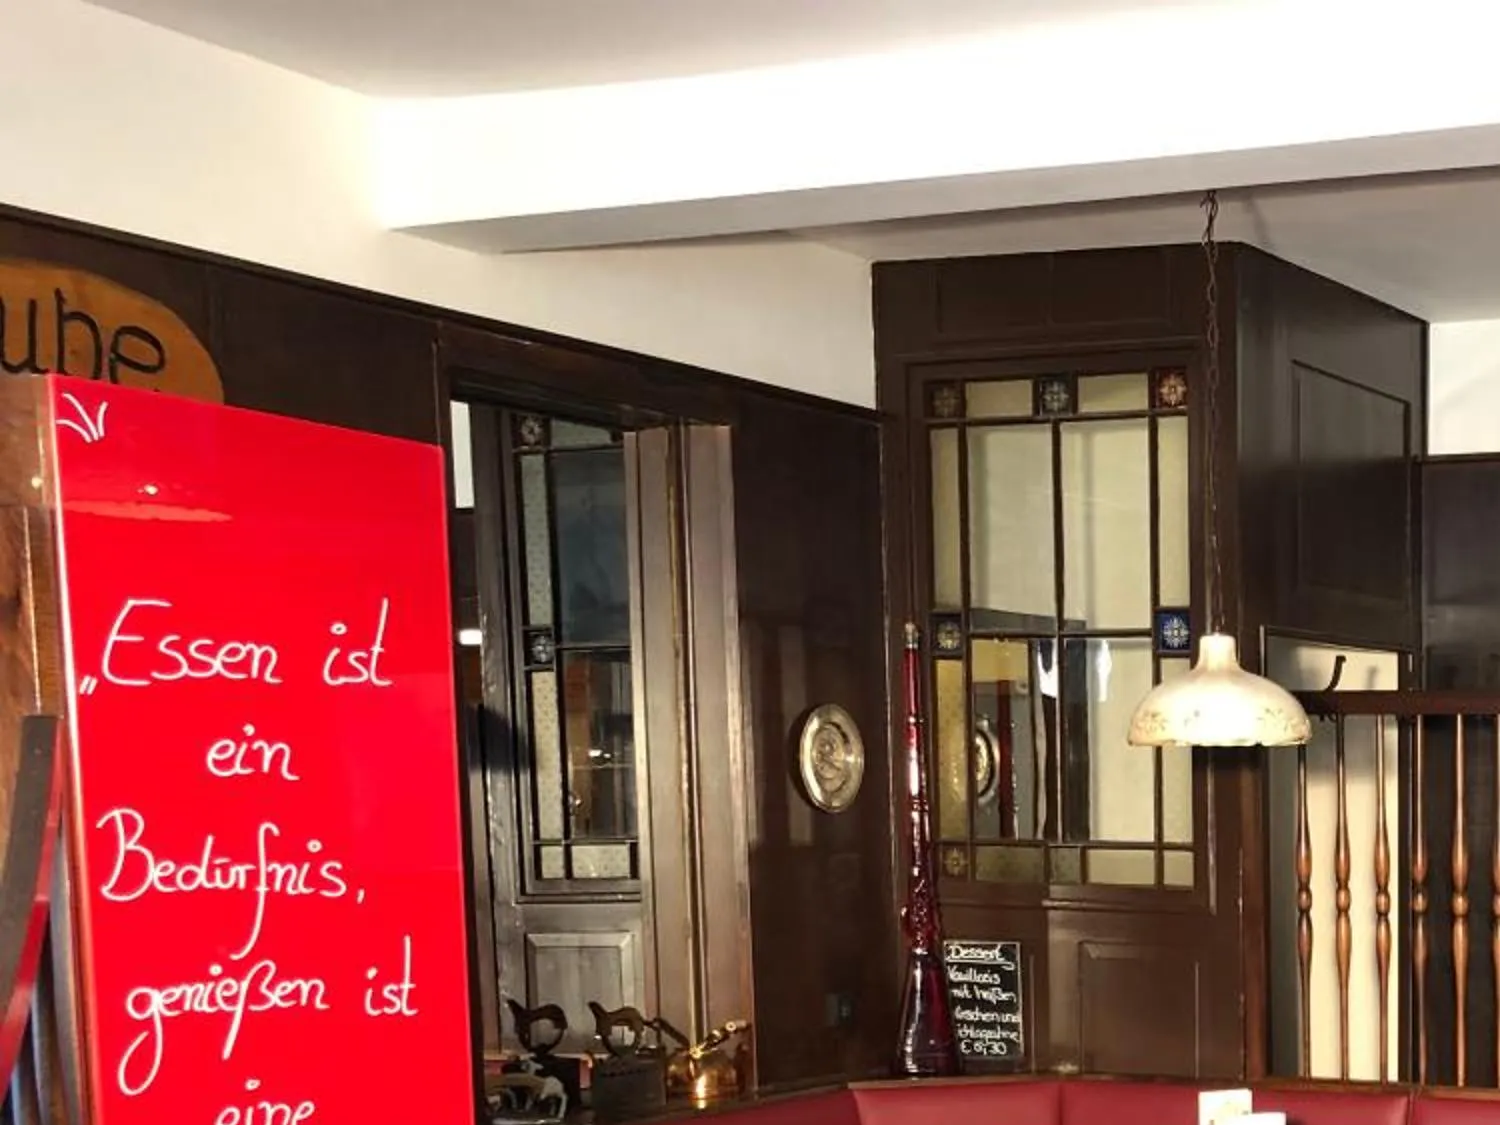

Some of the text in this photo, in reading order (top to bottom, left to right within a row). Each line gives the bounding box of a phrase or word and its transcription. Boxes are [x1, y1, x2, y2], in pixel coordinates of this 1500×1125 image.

[322, 597, 393, 687] ist
[205, 723, 300, 781] ein
[117, 935, 418, 1096] genießen ist
